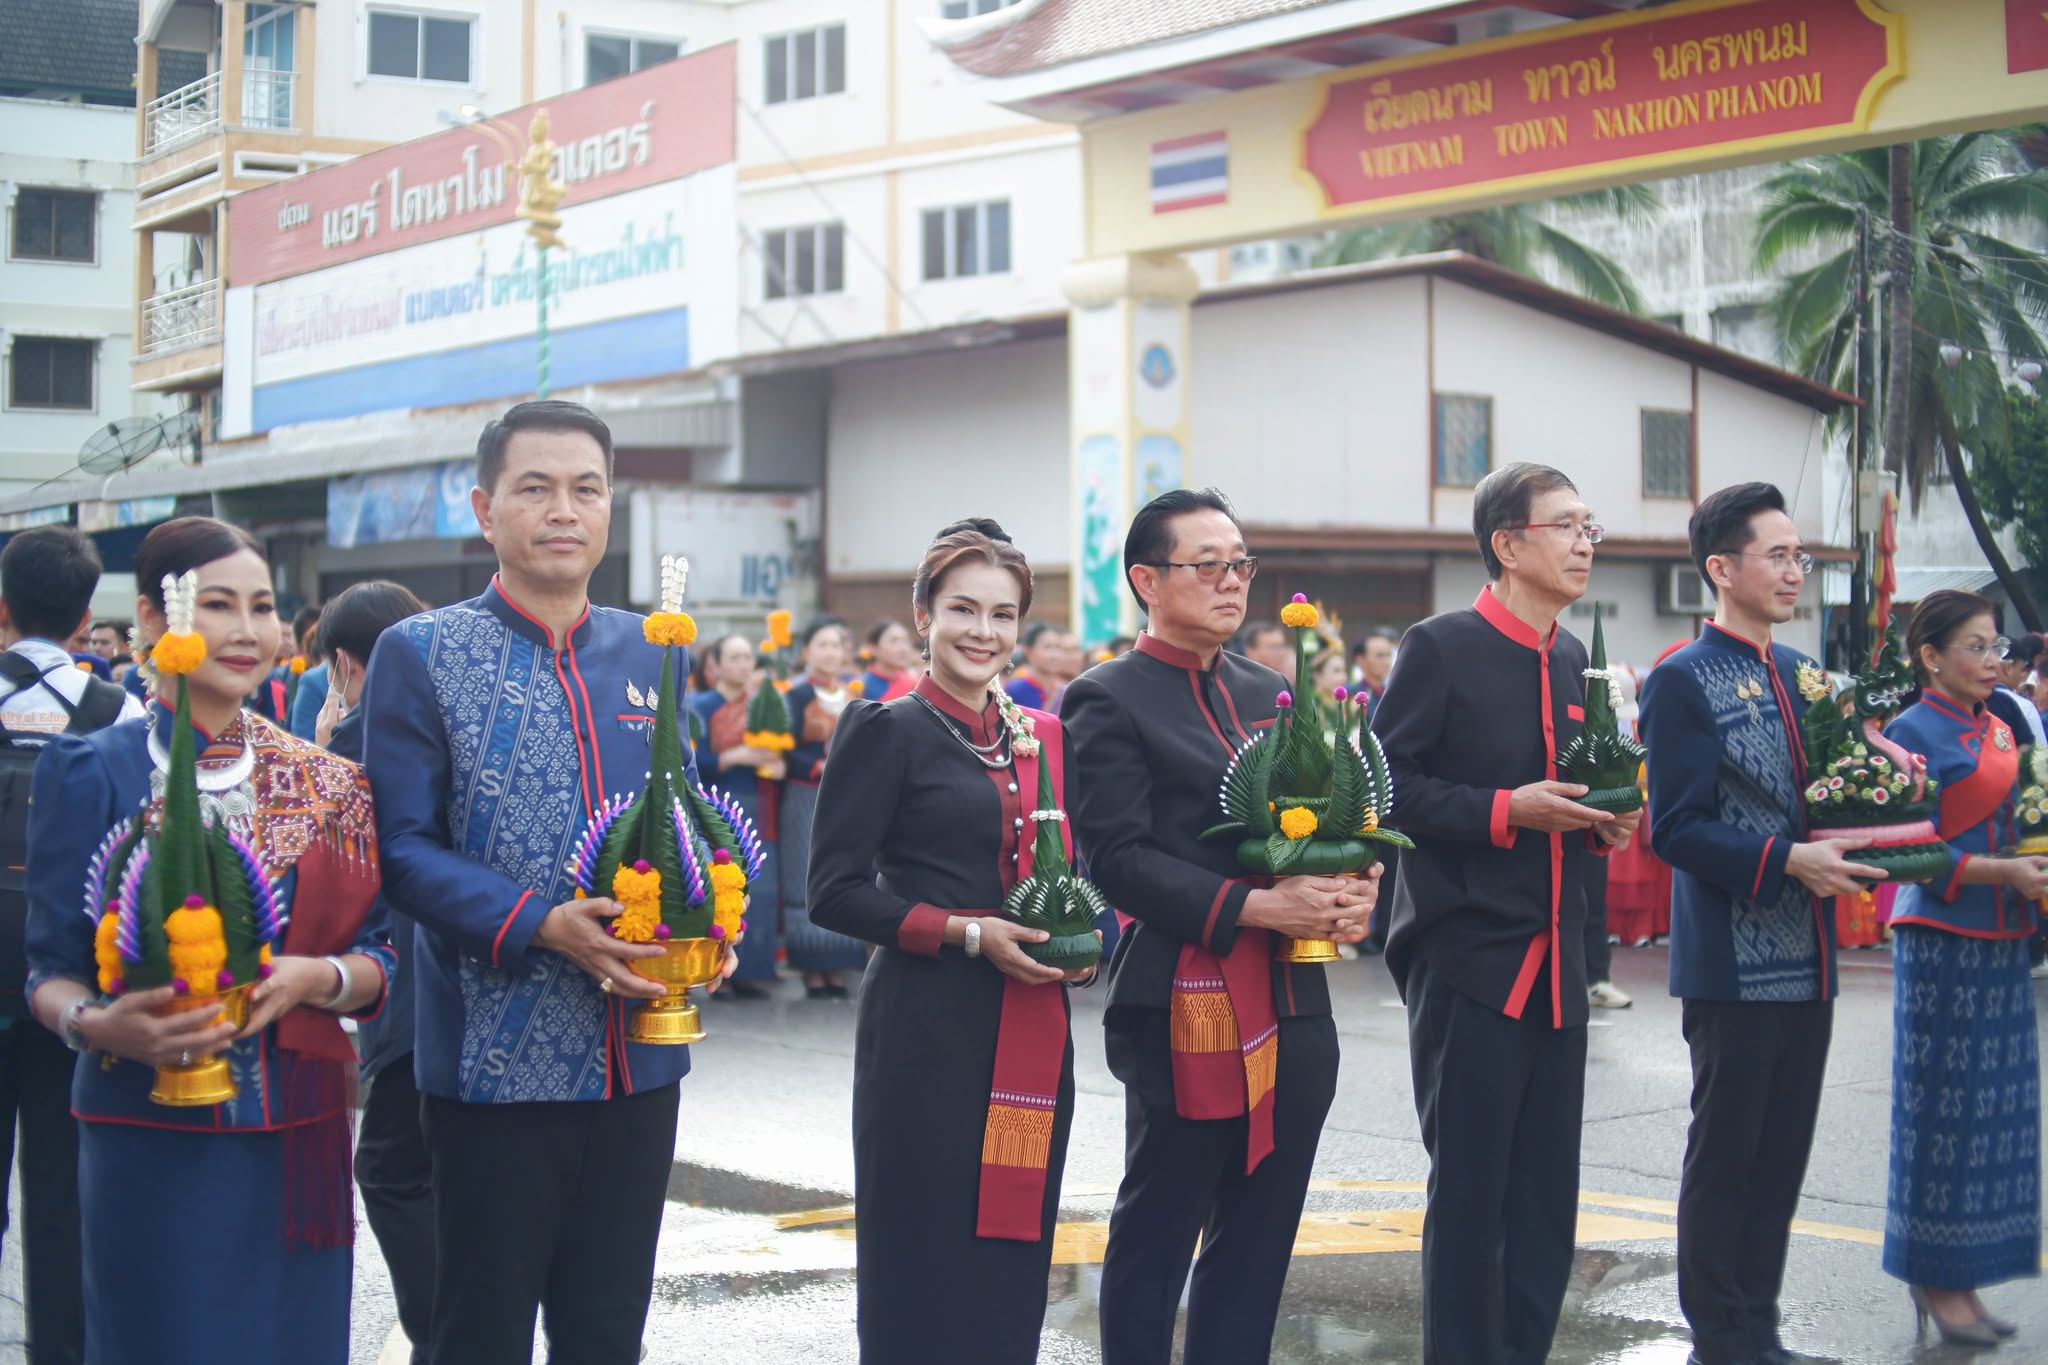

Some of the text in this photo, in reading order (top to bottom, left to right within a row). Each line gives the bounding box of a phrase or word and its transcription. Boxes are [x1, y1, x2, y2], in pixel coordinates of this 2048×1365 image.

[1360, 71, 1822, 179] VIETNAM TOWN NAKHON PHANOM
[1364, 20, 1807, 134] เวียดนาม ทาวน์ นครพนม
[321, 180, 382, 249] แอร์
[387, 144, 506, 232] ไดนาโม
